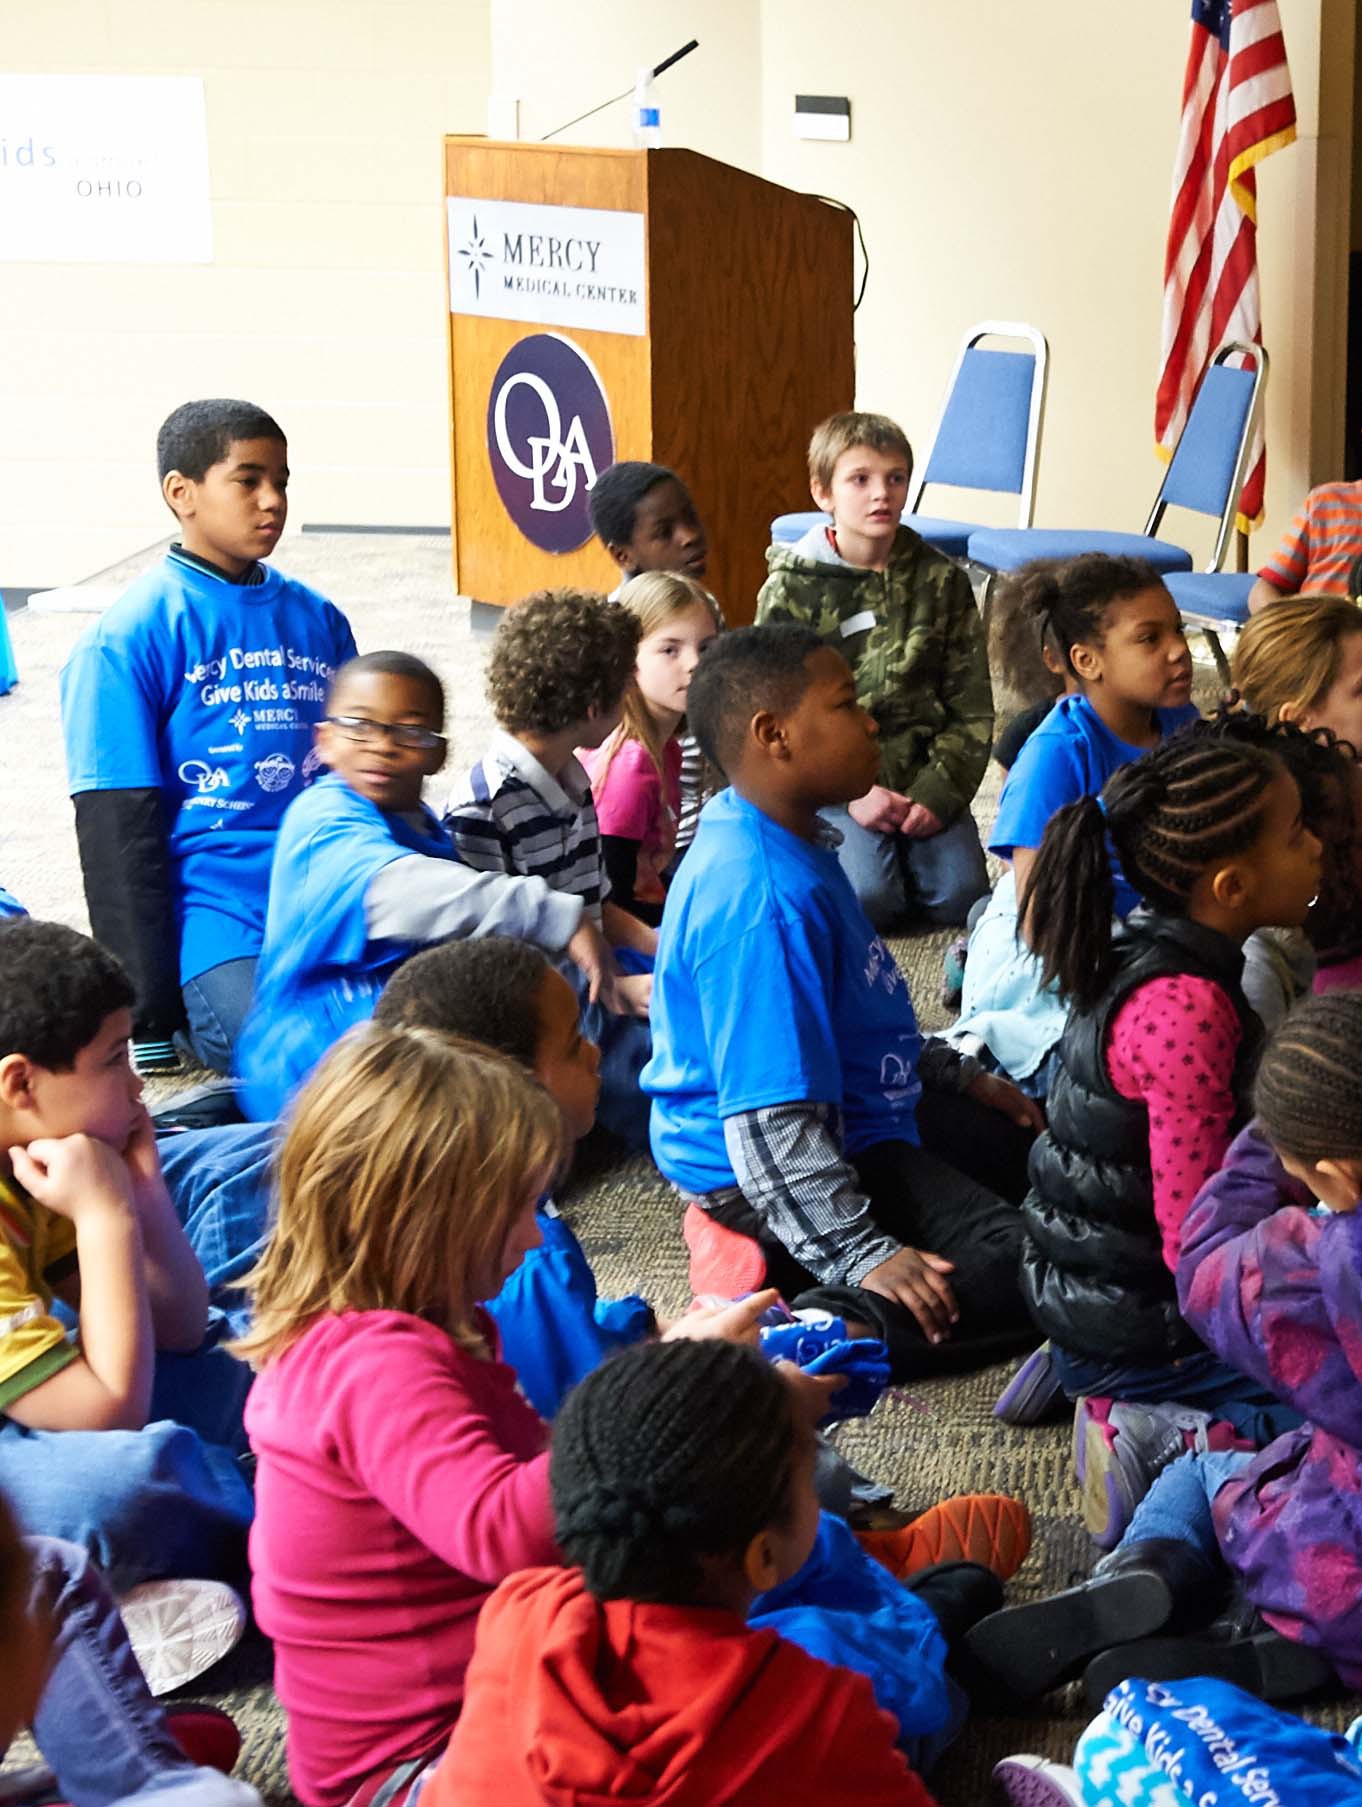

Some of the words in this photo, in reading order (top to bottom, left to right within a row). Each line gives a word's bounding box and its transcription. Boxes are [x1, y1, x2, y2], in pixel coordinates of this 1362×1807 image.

[76, 179, 142, 198] OHIO
[503, 233, 601, 273] MERCY
[503, 276, 571, 297] MEDICAL
[576, 283, 638, 305] CENTER
[229, 645, 286, 671] Dental
[200, 683, 242, 707] Give
[243, 677, 280, 702] Kids
[290, 680, 326, 704] Smile
[1144, 1721, 1185, 1788] Kids
[1171, 1704, 1258, 1776] Dental
